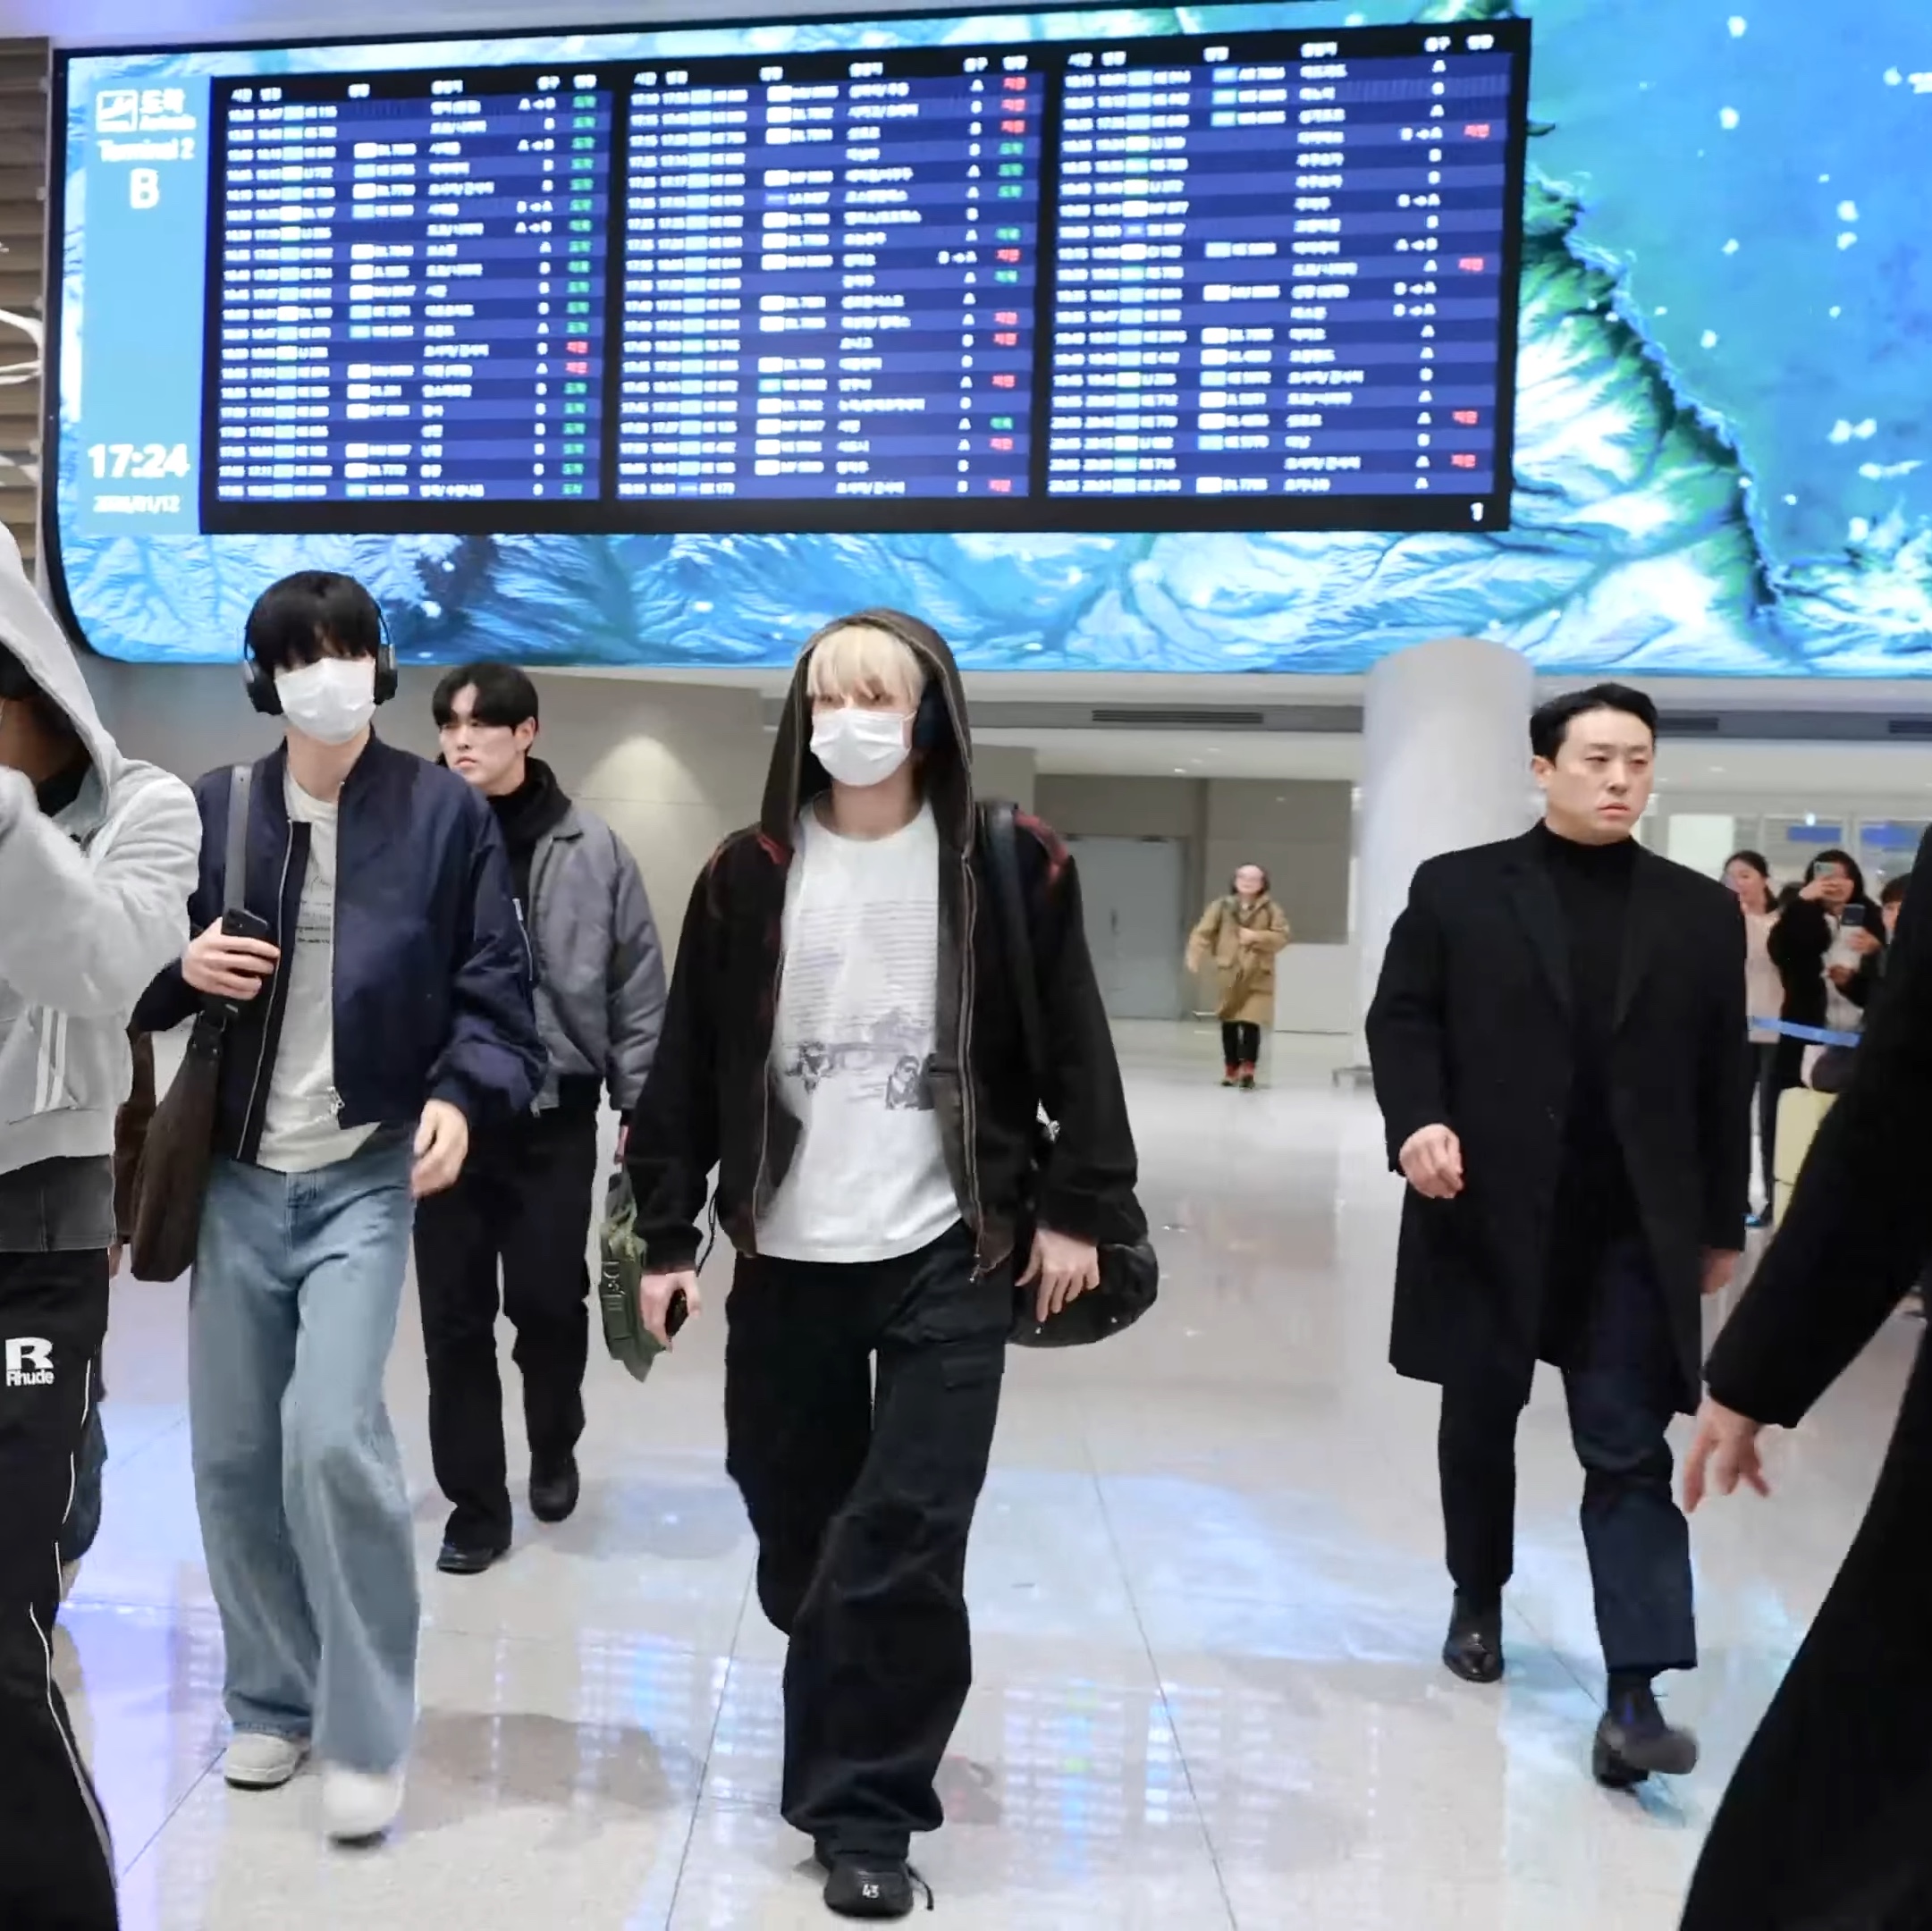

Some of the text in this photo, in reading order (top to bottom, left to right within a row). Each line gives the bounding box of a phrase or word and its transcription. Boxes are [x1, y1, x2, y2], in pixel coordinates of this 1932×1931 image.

[180, 137, 196, 160] 2
[130, 167, 159, 209] B
[87, 443, 191, 479] 17:24
[5, 1337, 54, 1369] R
[6, 1369, 55, 1387] Rhude
